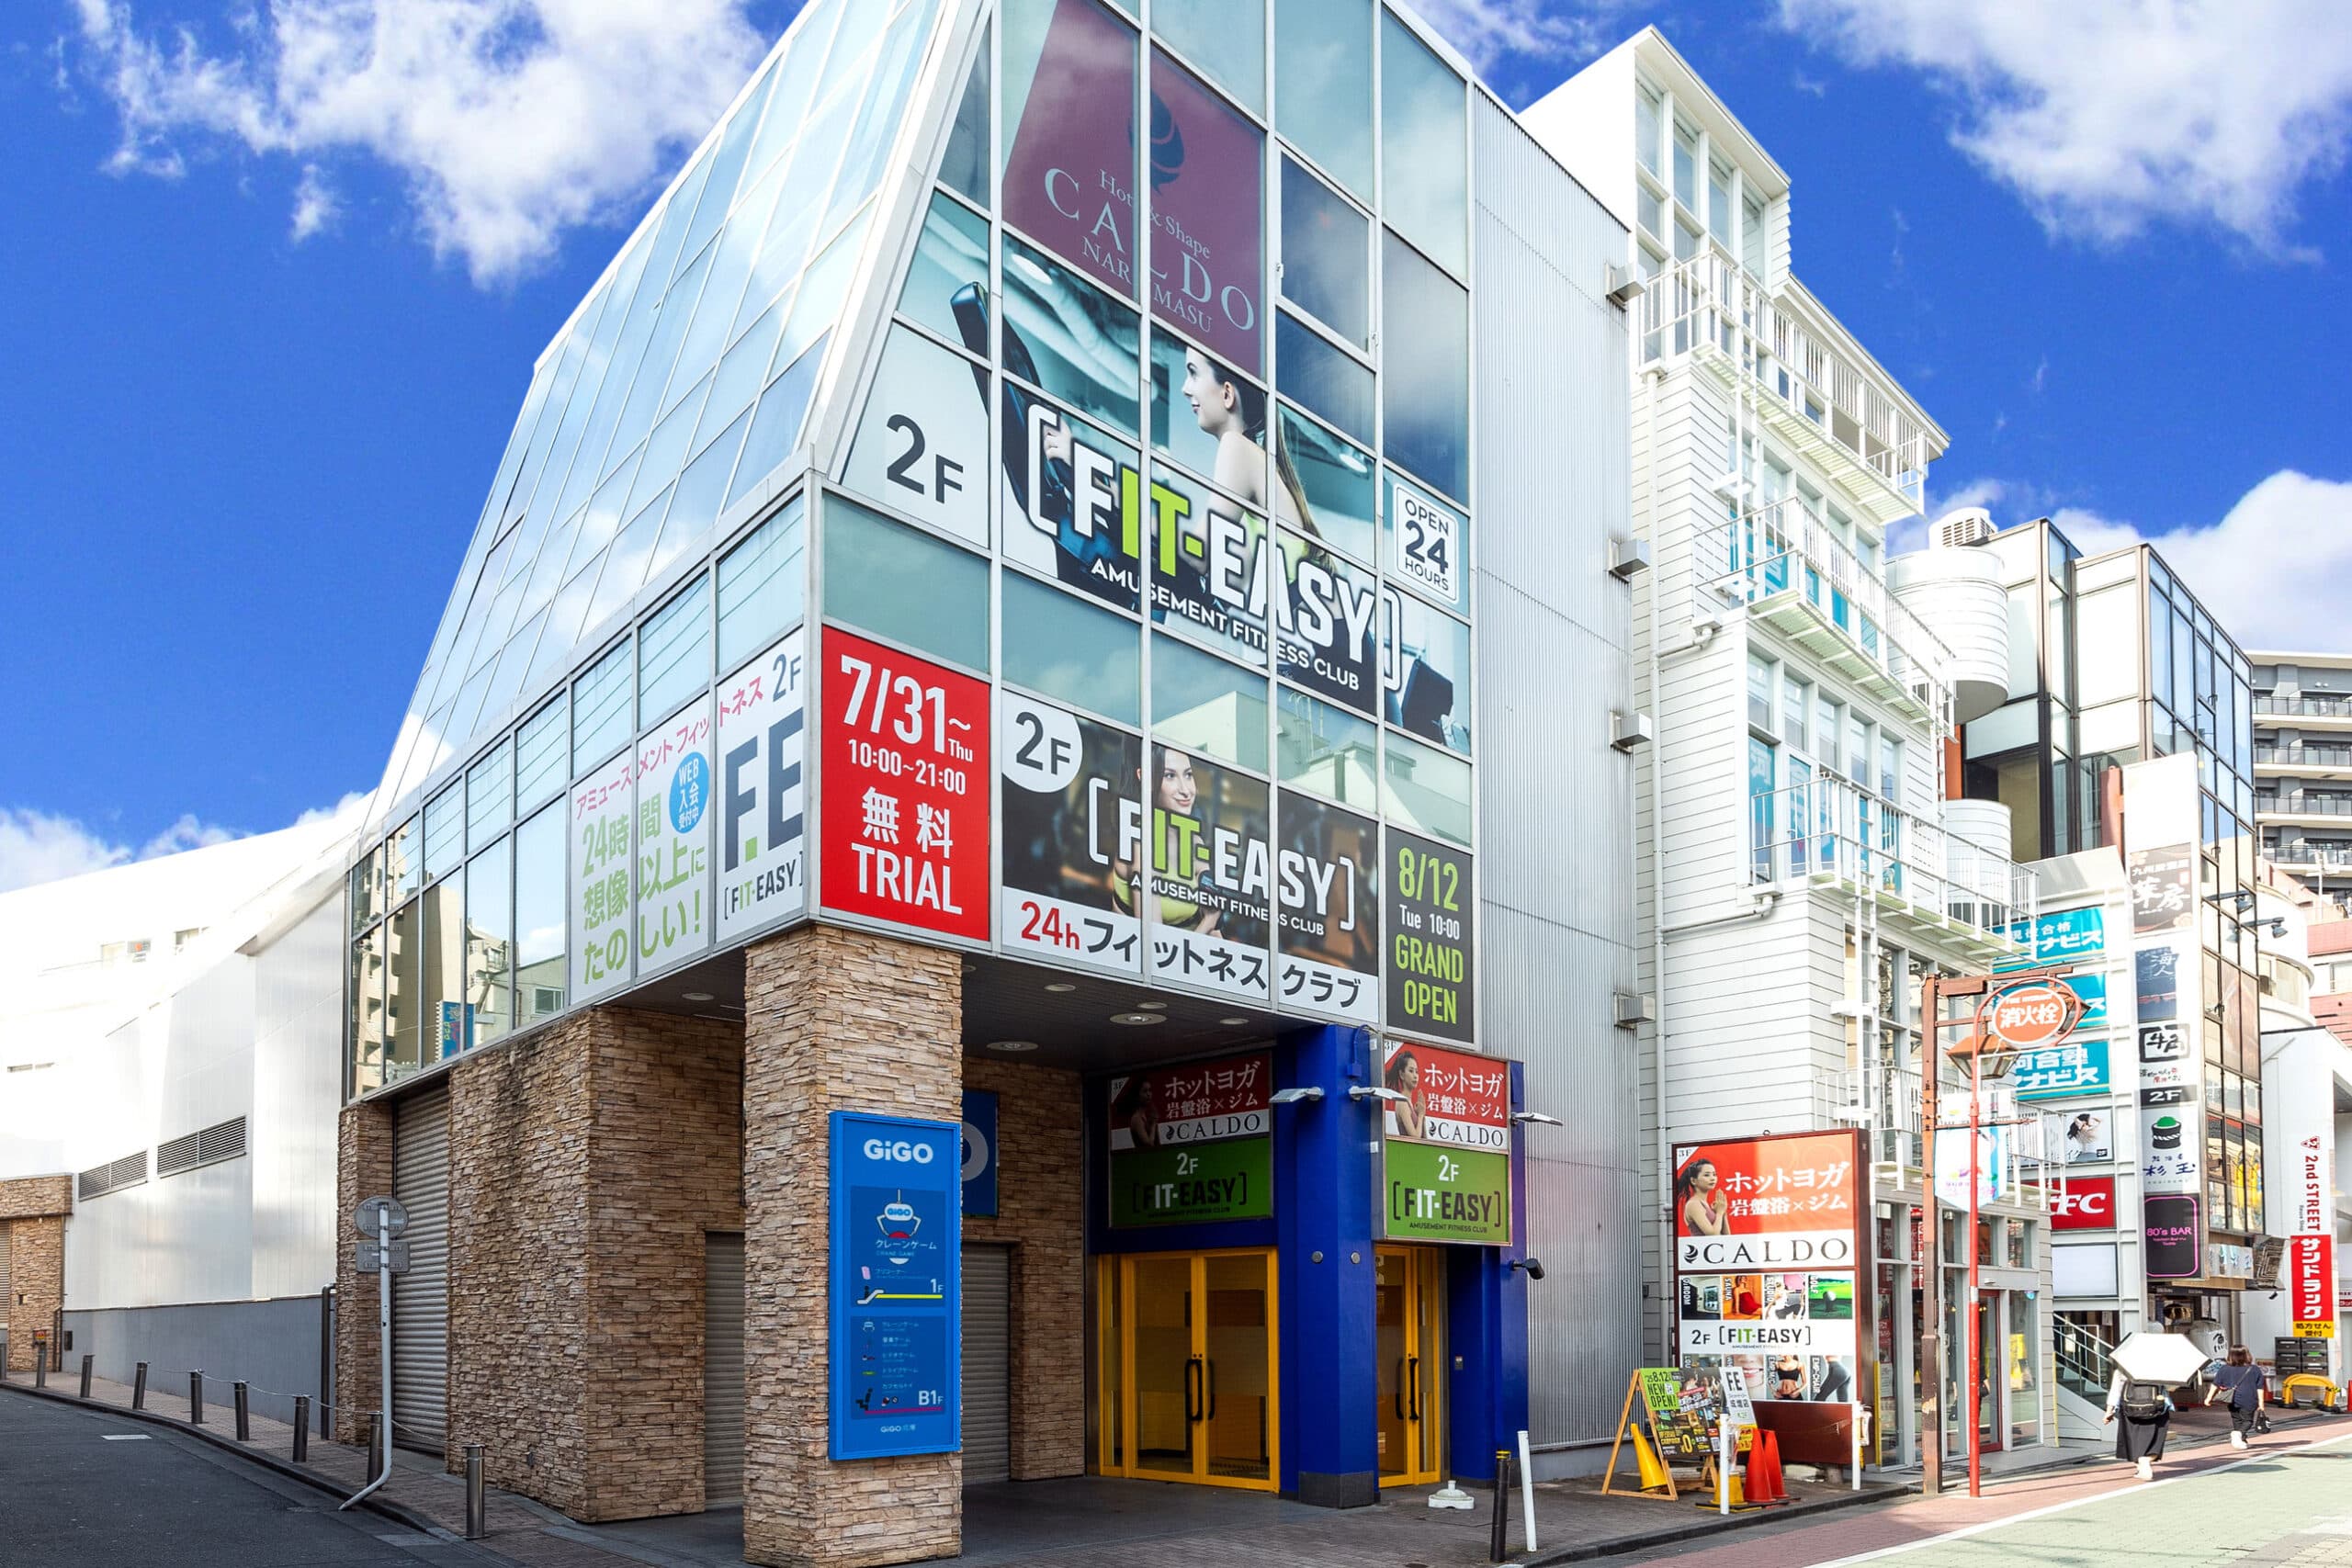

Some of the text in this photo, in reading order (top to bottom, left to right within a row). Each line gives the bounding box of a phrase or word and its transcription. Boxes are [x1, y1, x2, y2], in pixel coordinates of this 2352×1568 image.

[1099, 169, 1132, 207] Hot
[1165, 216, 1211, 259] Shape
[1082, 236, 1213, 333] NARMASU
[887, 414, 963, 504] 2F
[1406, 500, 1449, 536] OPEN
[1406, 521, 1449, 574] 24
[1406, 557, 1449, 591] HOURS
[773, 653, 801, 702] 2F
[1314, 658, 1360, 690] CLUB
[948, 738, 973, 762] Thu
[1015, 711, 1071, 775] 2F
[678, 758, 699, 786] WEB
[679, 783, 699, 812] 入会
[582, 793, 661, 878] 24時間
[862, 785, 954, 859] 無料
[583, 837, 705, 931] 想像以上に
[851, 842, 963, 915] TRIAL
[1398, 847, 1459, 912] 8/12
[1230, 900, 1287, 926] FITNES
[1291, 917, 1325, 935] CLUB
[1399, 904, 1460, 941] Tue 10:00
[1396, 933, 1464, 983] GRAND
[1404, 979, 1457, 1024] OPEN
[2000, 1003, 2060, 1028] 消火栓
[1385, 1040, 1396, 1051] 3F
[1165, 1060, 1261, 1100] ホットヨガ
[1424, 1063, 1504, 1099] ホットヨガ
[2150, 1089, 2183, 1102] 2F
[1177, 1113, 1261, 1140] CALDO
[1438, 1122, 1504, 1147] CALDO
[864, 1138, 933, 1164] GiGO
[1177, 1152, 1199, 1176] 2F
[1439, 1155, 1459, 1182] 2F
[1724, 1161, 1850, 1194] ホットヨガ
[2143, 1162, 2196, 1177] 杉玉
[2050, 1193, 2107, 1215] FC
[2305, 1155, 2321, 1232] 2nd STREET
[875, 1239, 937, 1250] クレーンゲーム
[1409, 1223, 1487, 1234] AMUSEMENT FITNESS CLUB
[2147, 1226, 2192, 1236] 80's BAR
[1703, 1238, 1848, 1264] CALDO
[930, 1278, 944, 1293] 1F
[2301, 1237, 2322, 1320] サンドラッグ
[1691, 1329, 1711, 1345] 2F
[919, 1390, 944, 1405] B1F
[1647, 1384, 1665, 1395] NEW
[1651, 1395, 1676, 1408] OPEN!
